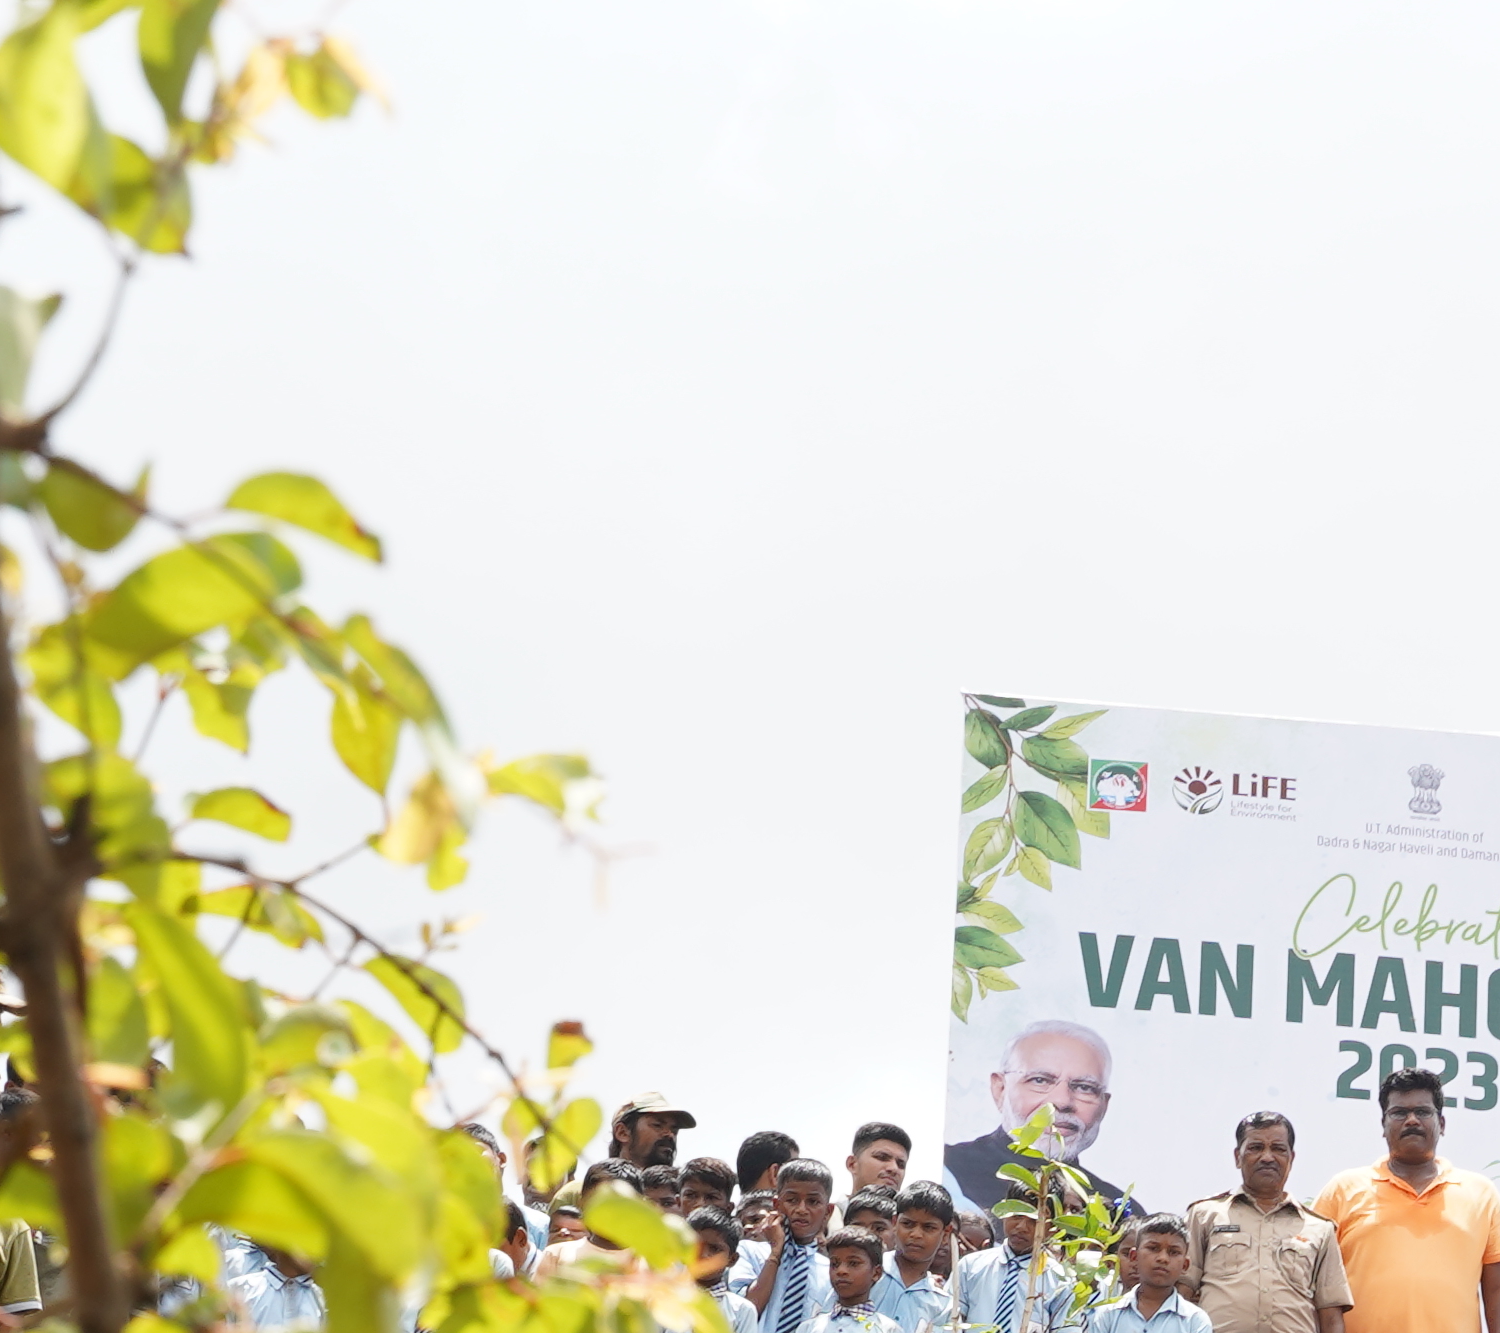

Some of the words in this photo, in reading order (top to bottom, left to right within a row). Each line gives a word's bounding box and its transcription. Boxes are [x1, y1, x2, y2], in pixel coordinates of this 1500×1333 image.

[1232, 773, 1297, 801] LiFE
[1230, 800, 1275, 812] Lifestyle
[1277, 804, 1293, 813] for
[1230, 808, 1297, 822] Environment
[1386, 824, 1470, 842] Administration
[1472, 832, 1485, 843] of
[1317, 835, 1350, 849] Dadra
[1352, 838, 1360, 850] &
[1363, 839, 1397, 853] Nagar
[1399, 842, 1434, 855] Haveli
[1436, 846, 1458, 858] and
[1461, 847, 1500, 862] Daman
[1078, 931, 1255, 1019] VAN
